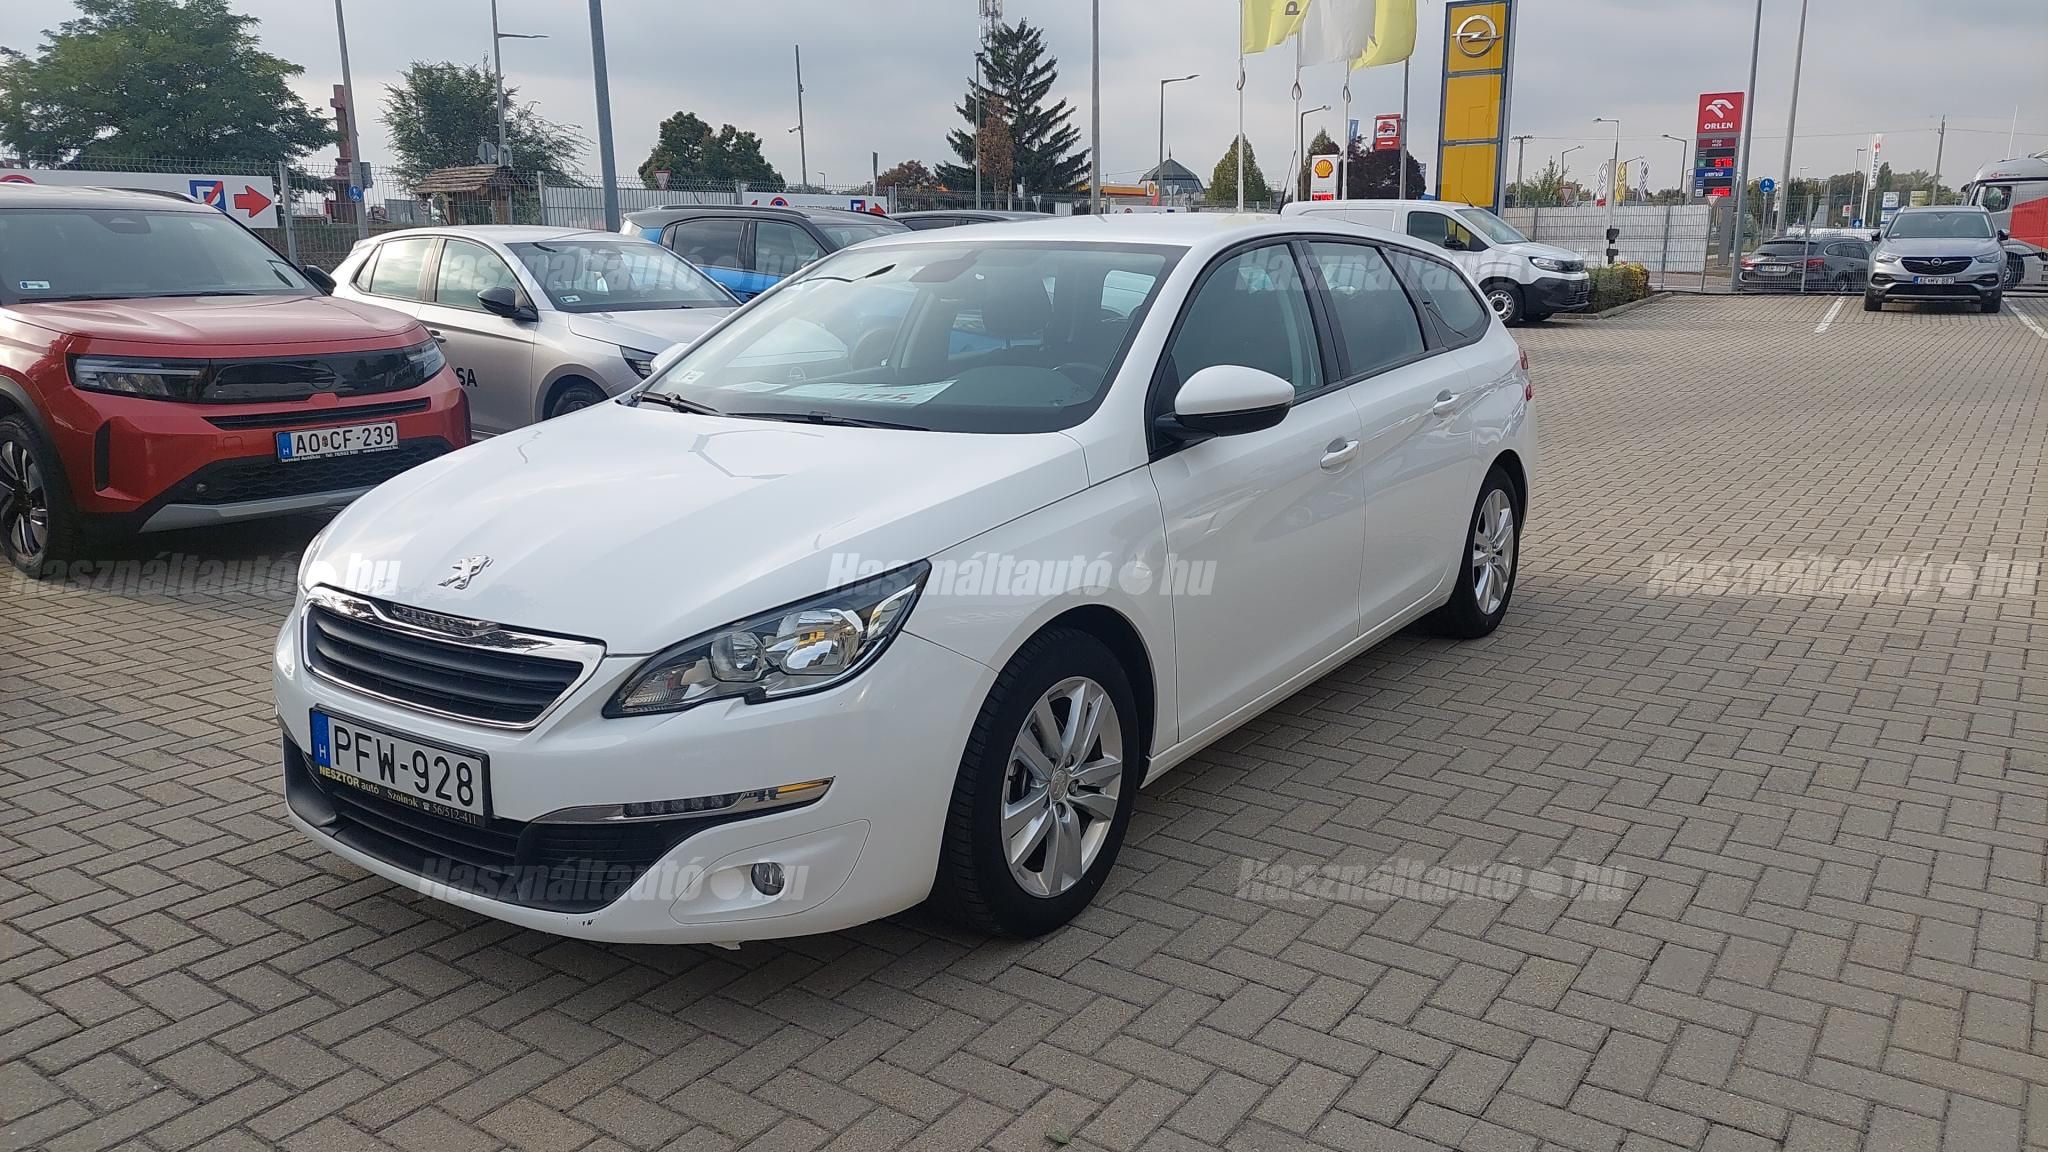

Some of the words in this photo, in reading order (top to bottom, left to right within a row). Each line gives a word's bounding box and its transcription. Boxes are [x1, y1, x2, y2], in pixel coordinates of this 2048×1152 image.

[1704, 122, 1733, 130] ORLEN
[451, 367, 478, 387] SA
[318, 743, 327, 760] H
[333, 725, 475, 808] PFW-928
[319, 766, 361, 788] NESZTOR
[360, 780, 381, 796] autó
[386, 789, 419, 809] Szolnok
[432, 802, 478, 826] 56/512-411
